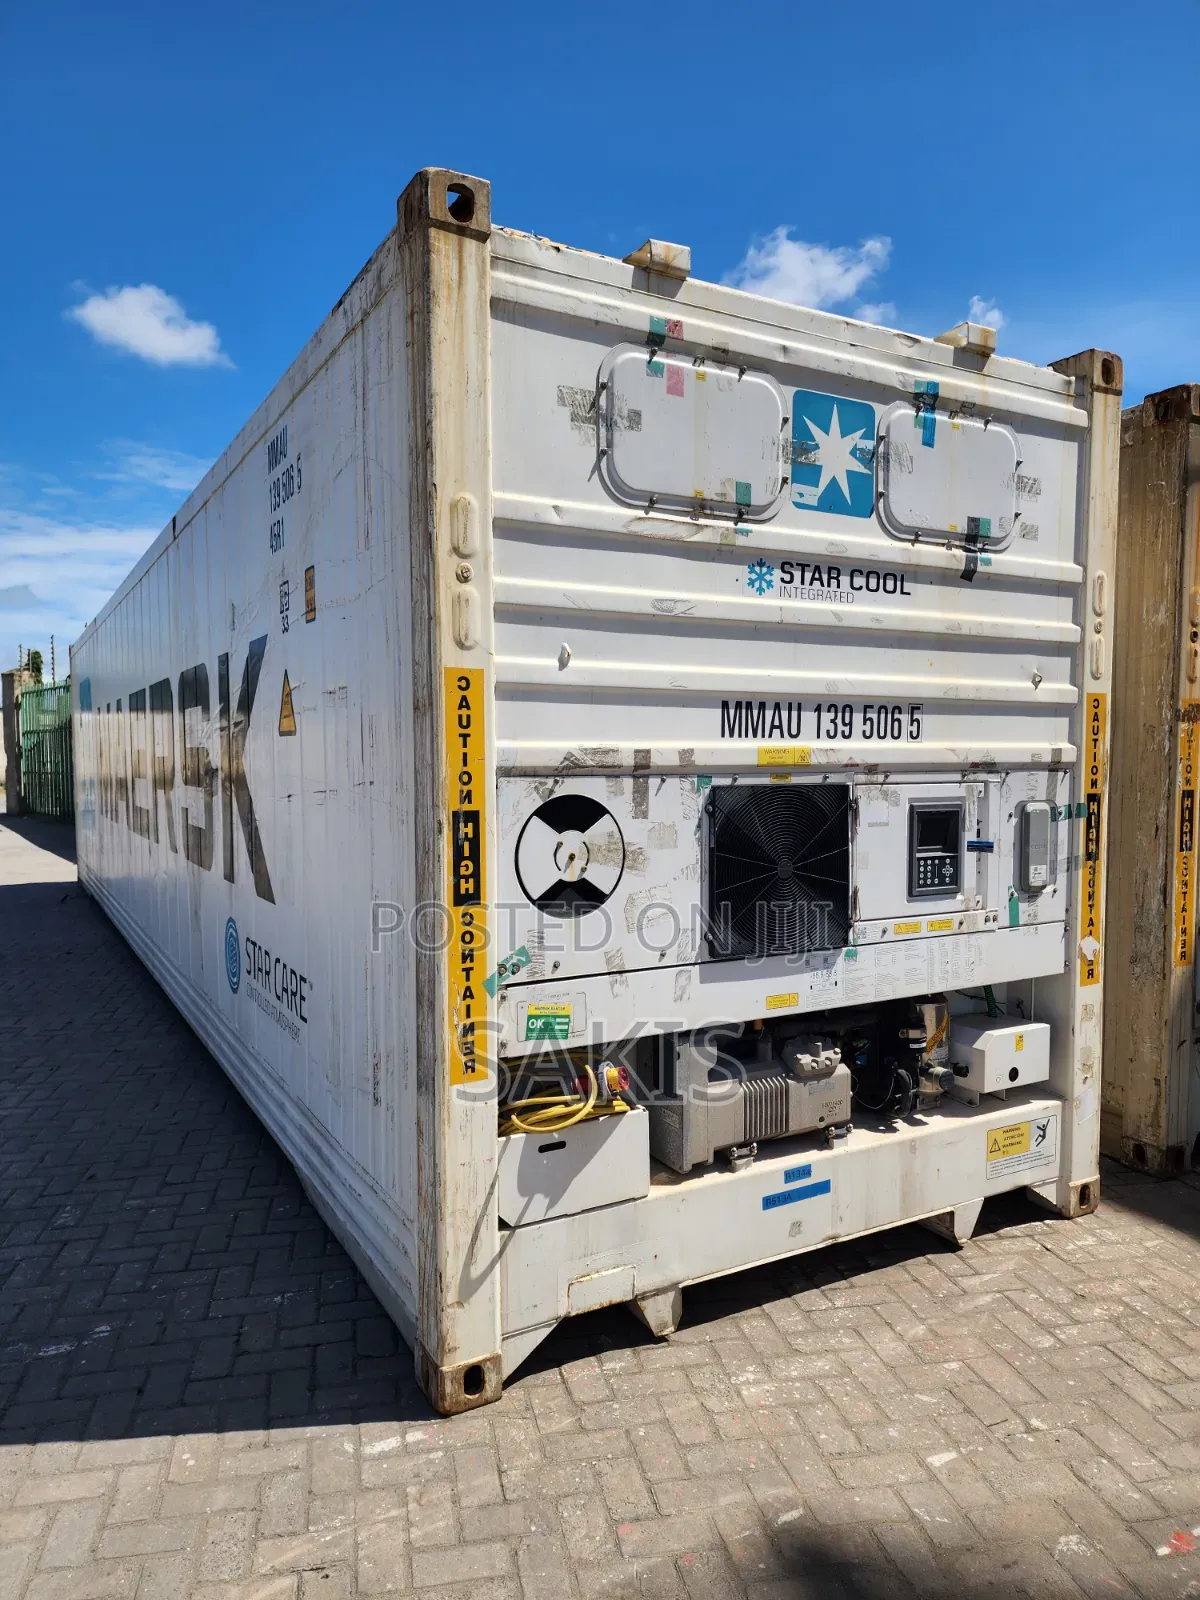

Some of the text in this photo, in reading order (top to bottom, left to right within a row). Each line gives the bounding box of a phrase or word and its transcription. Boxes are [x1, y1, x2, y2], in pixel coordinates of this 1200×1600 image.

[267, 424, 288, 475] MMAU
[269, 477, 281, 514] 139
[282, 464, 295, 505] 506
[269, 516, 285, 556] 45R1
[779, 585, 855, 604] INTEGRATED
[780, 561, 911, 596] STAR COOL
[721, 700, 921, 741] MMAU 139 506 5
[245, 936, 308, 1024] STAR CARE
[528, 1018, 545, 1029] OK
[765, 1193, 792, 1207] R513A
